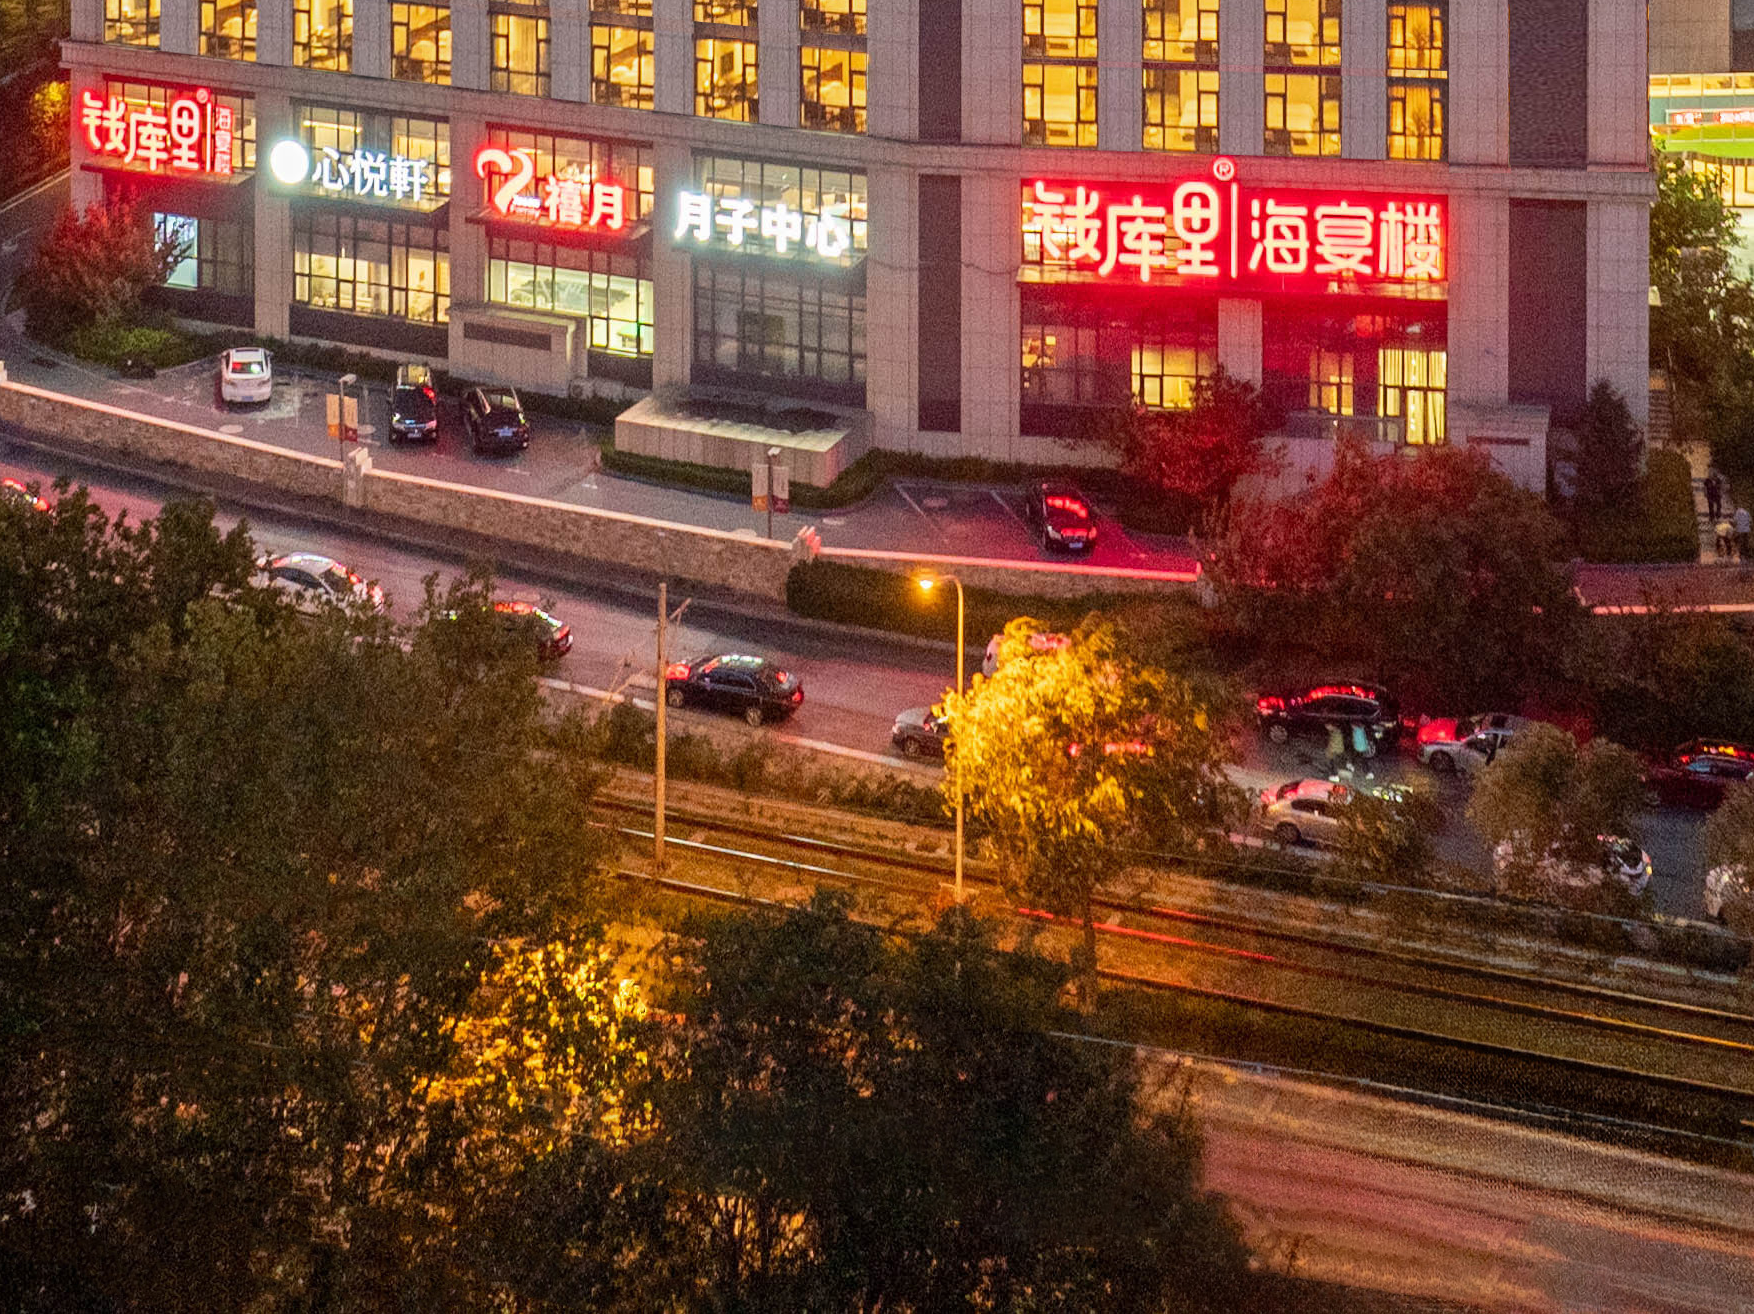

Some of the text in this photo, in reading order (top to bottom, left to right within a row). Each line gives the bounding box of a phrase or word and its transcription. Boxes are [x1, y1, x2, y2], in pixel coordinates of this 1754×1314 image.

[81, 90, 200, 172] 钱库里
[545, 175, 623, 229] 禧月
[675, 190, 851, 258] 月子中心
[1031, 180, 1443, 282] 钱库里 海宴楼
